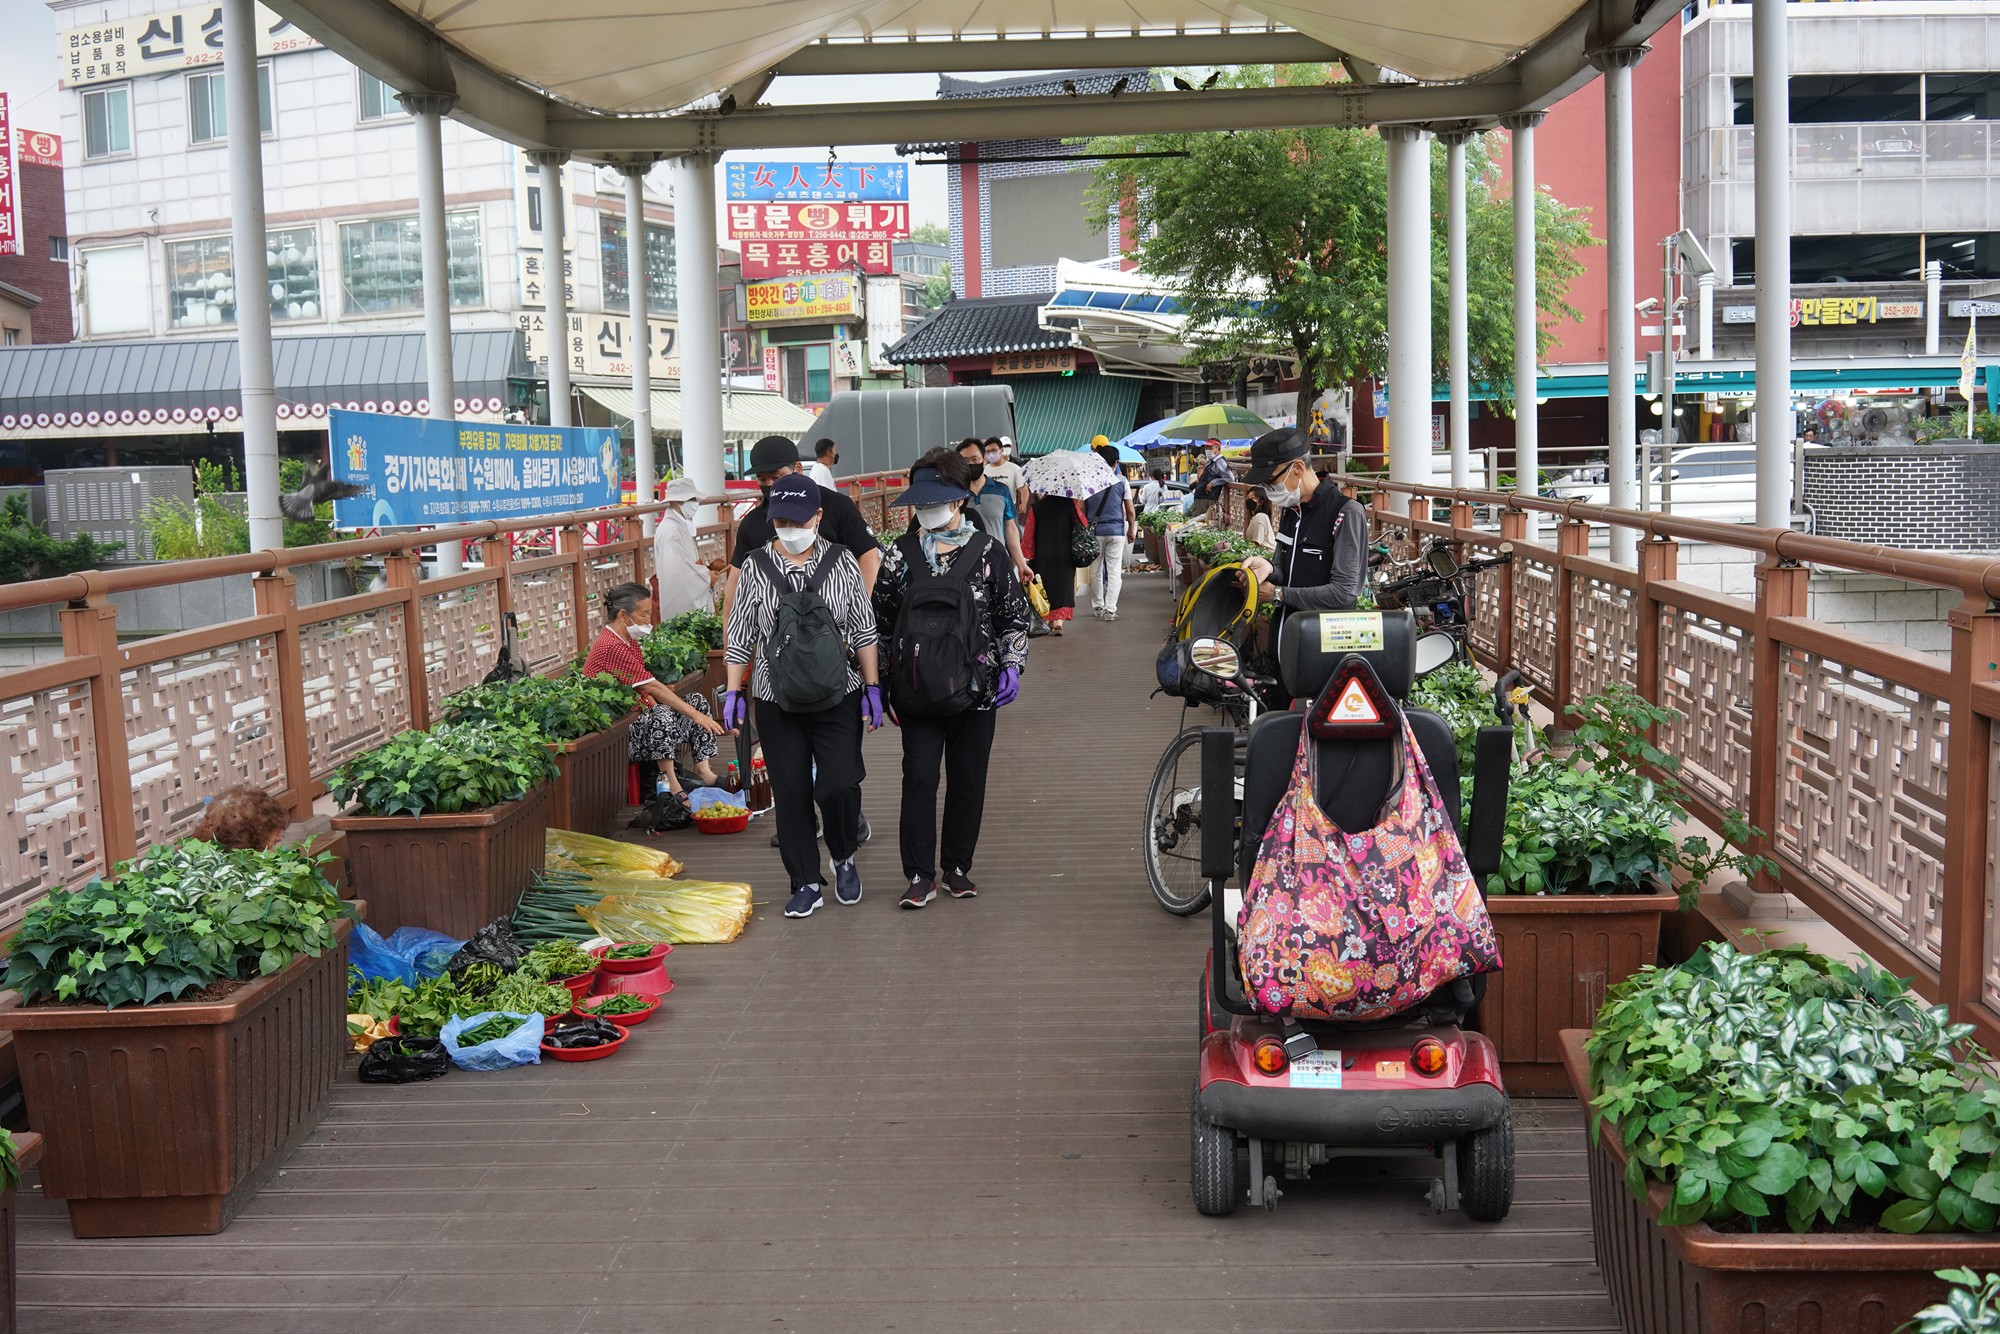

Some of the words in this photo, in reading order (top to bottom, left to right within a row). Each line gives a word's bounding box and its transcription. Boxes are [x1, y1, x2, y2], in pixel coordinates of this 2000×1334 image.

[69, 27, 125, 48] 업소용설비
[749, 164, 878, 190] 女人天下
[746, 241, 889, 268] 목포홍어회
[748, 285, 780, 306] 방앗간
[783, 286, 799, 301] 고추
[801, 285, 816, 300] 기름
[818, 282, 849, 298] 미숫가루
[1884, 304, 1918, 316] 252-3976
[996, 353, 1071, 371] 못골종합시장
[459, 430, 485, 450] 부정유통
[486, 431, 500, 451] 금지!
[505, 433, 528, 451] 지역화폐
[550, 434, 563, 451] 금지!
[384, 454, 467, 494] 경기지역화폐
[523, 456, 560, 489] 올바르게
[562, 456, 600, 487] 사용합시다.
[1403, 1108, 1470, 1128] 케어라인
